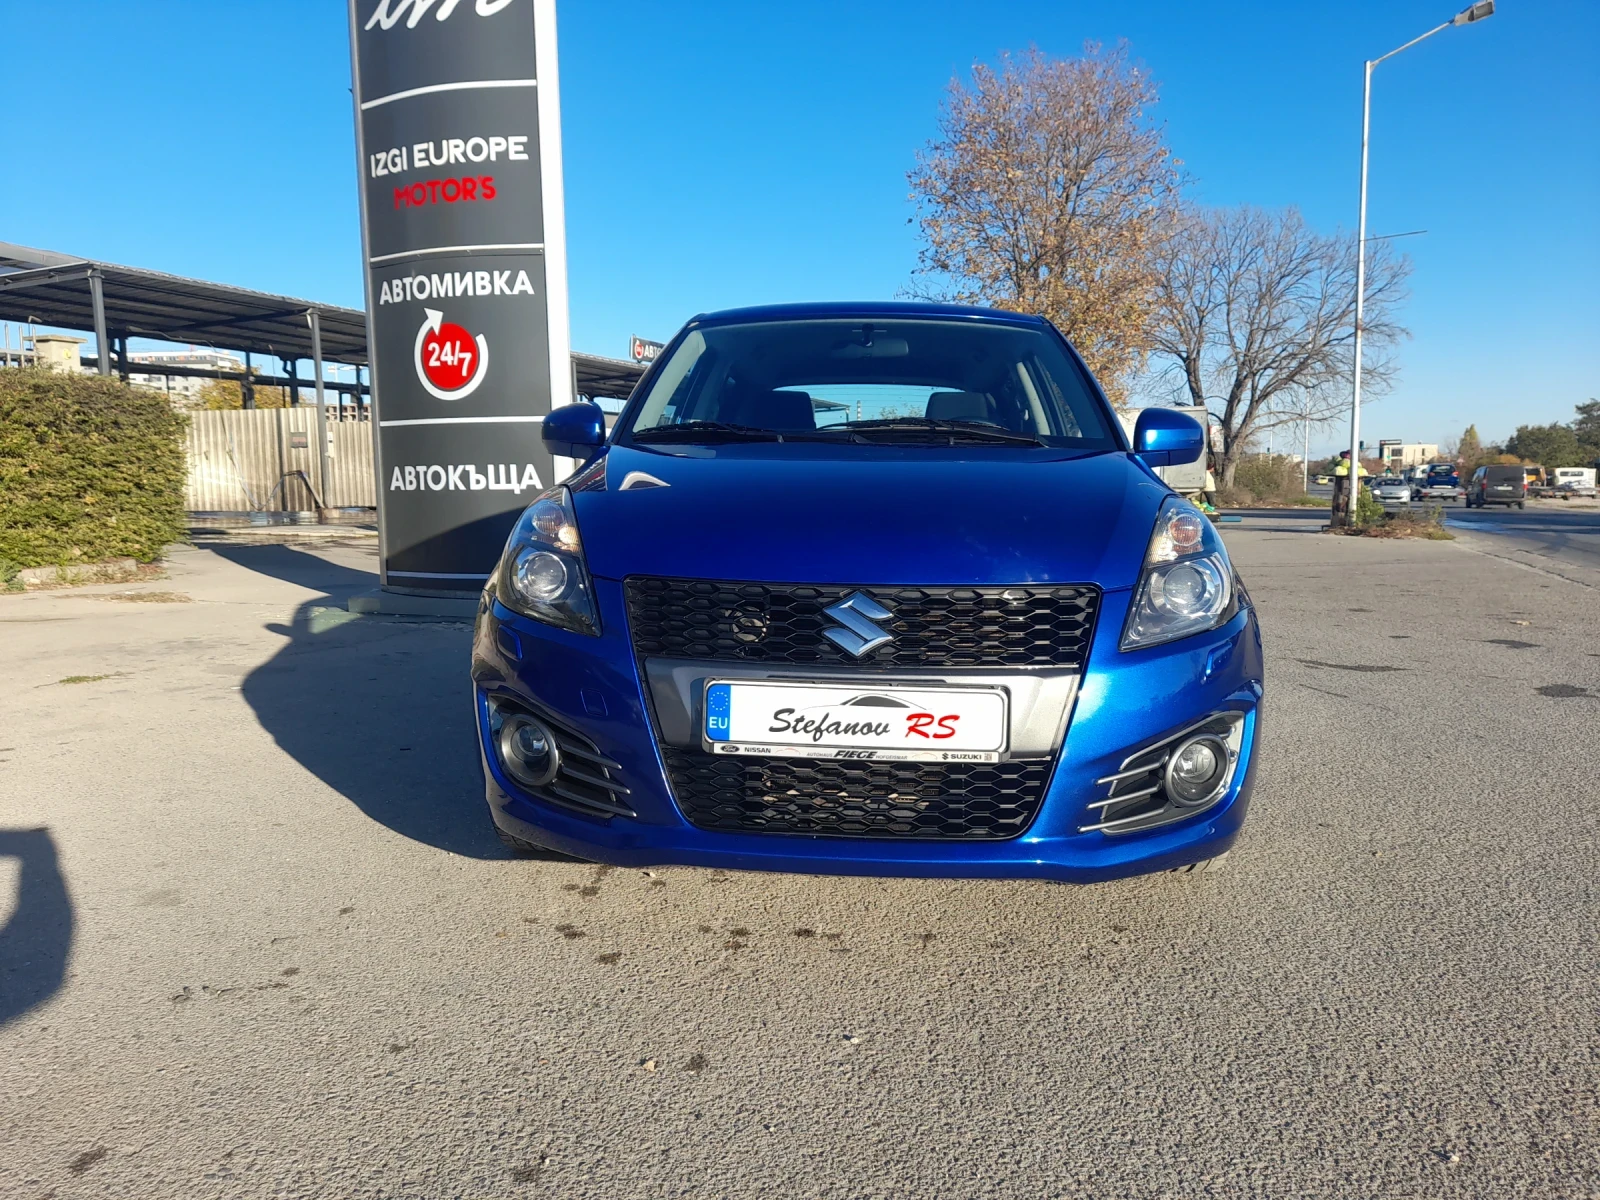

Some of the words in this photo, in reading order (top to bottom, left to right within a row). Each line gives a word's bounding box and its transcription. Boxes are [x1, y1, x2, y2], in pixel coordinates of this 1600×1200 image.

[370, 147, 408, 178] IZGI
[413, 136, 529, 168] EUROPE
[393, 175, 496, 209] MOTOR'S
[379, 270, 535, 305] АВТОМИВКА
[428, 340, 472, 376] 24/7
[390, 463, 543, 494] АВТОКЪЩА
[709, 716, 728, 729] EU
[769, 708, 891, 742] Stefanov
[905, 713, 960, 739] RS
[833, 750, 878, 759] FIEGE
